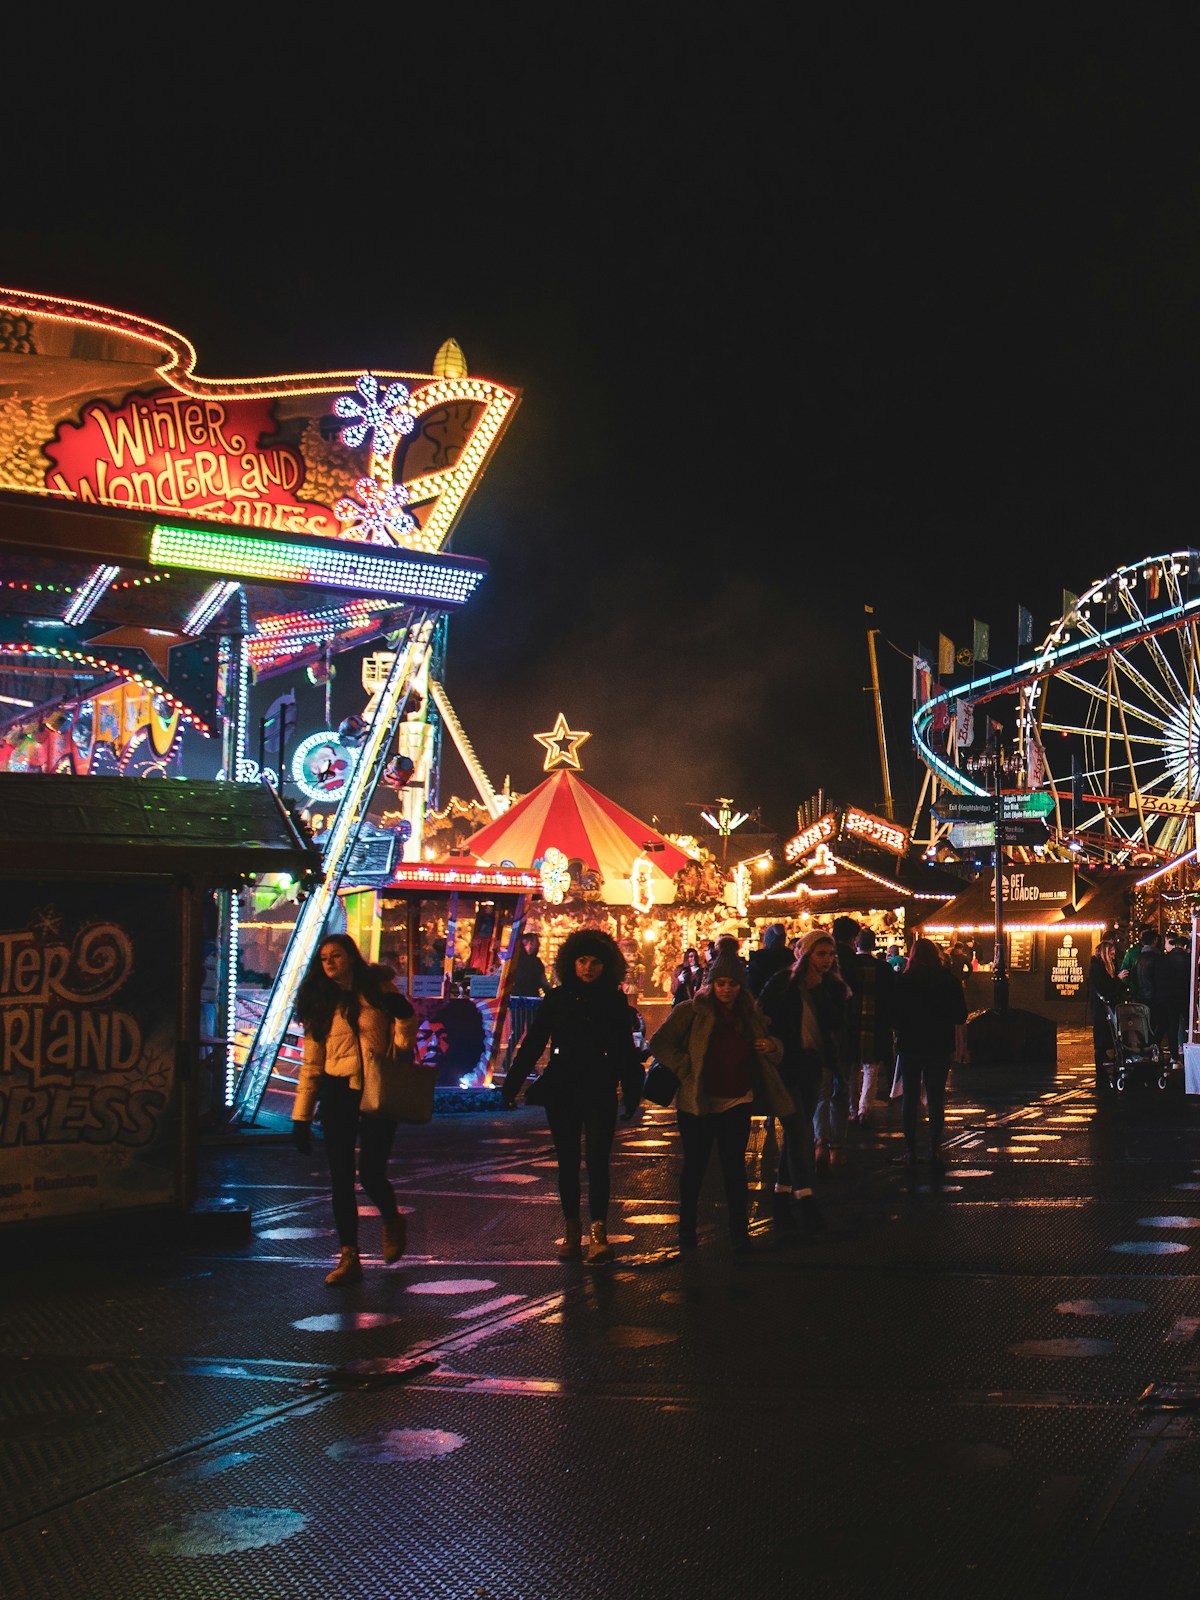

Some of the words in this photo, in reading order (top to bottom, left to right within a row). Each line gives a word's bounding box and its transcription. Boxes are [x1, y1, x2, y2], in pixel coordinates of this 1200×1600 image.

[1141, 796, 1193, 813] Bart
[1010, 874, 1025, 887] GET
[1010, 886, 1039, 901] LOADED
[1071, 948, 1078, 957] UP
